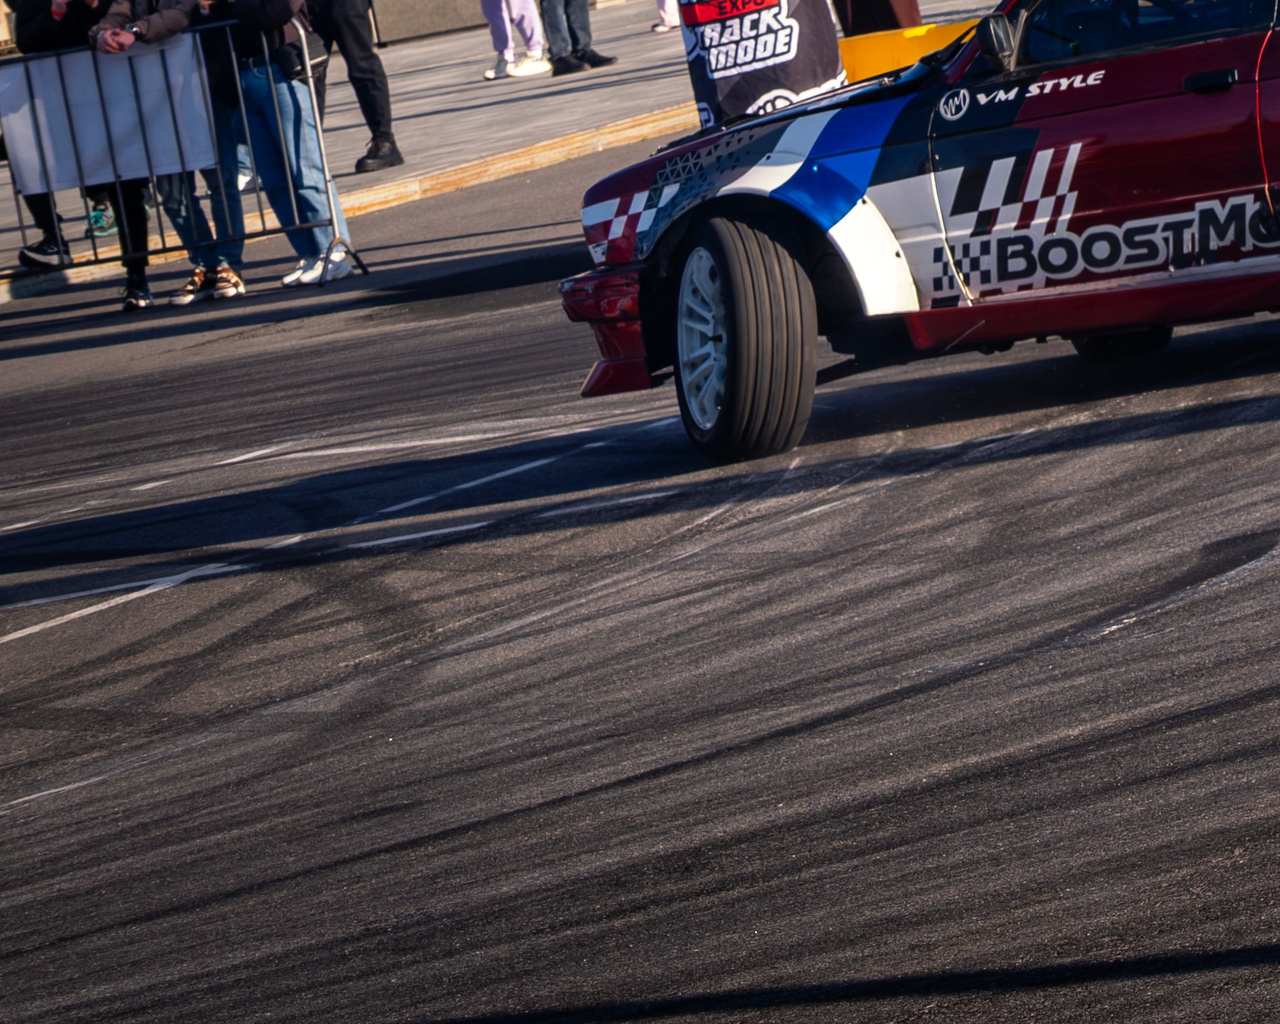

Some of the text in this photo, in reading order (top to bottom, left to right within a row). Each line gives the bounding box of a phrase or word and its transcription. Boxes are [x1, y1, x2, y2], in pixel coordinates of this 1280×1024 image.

[709, 27, 791, 71] MODE
[976, 70, 1106, 105] VM STYLE
